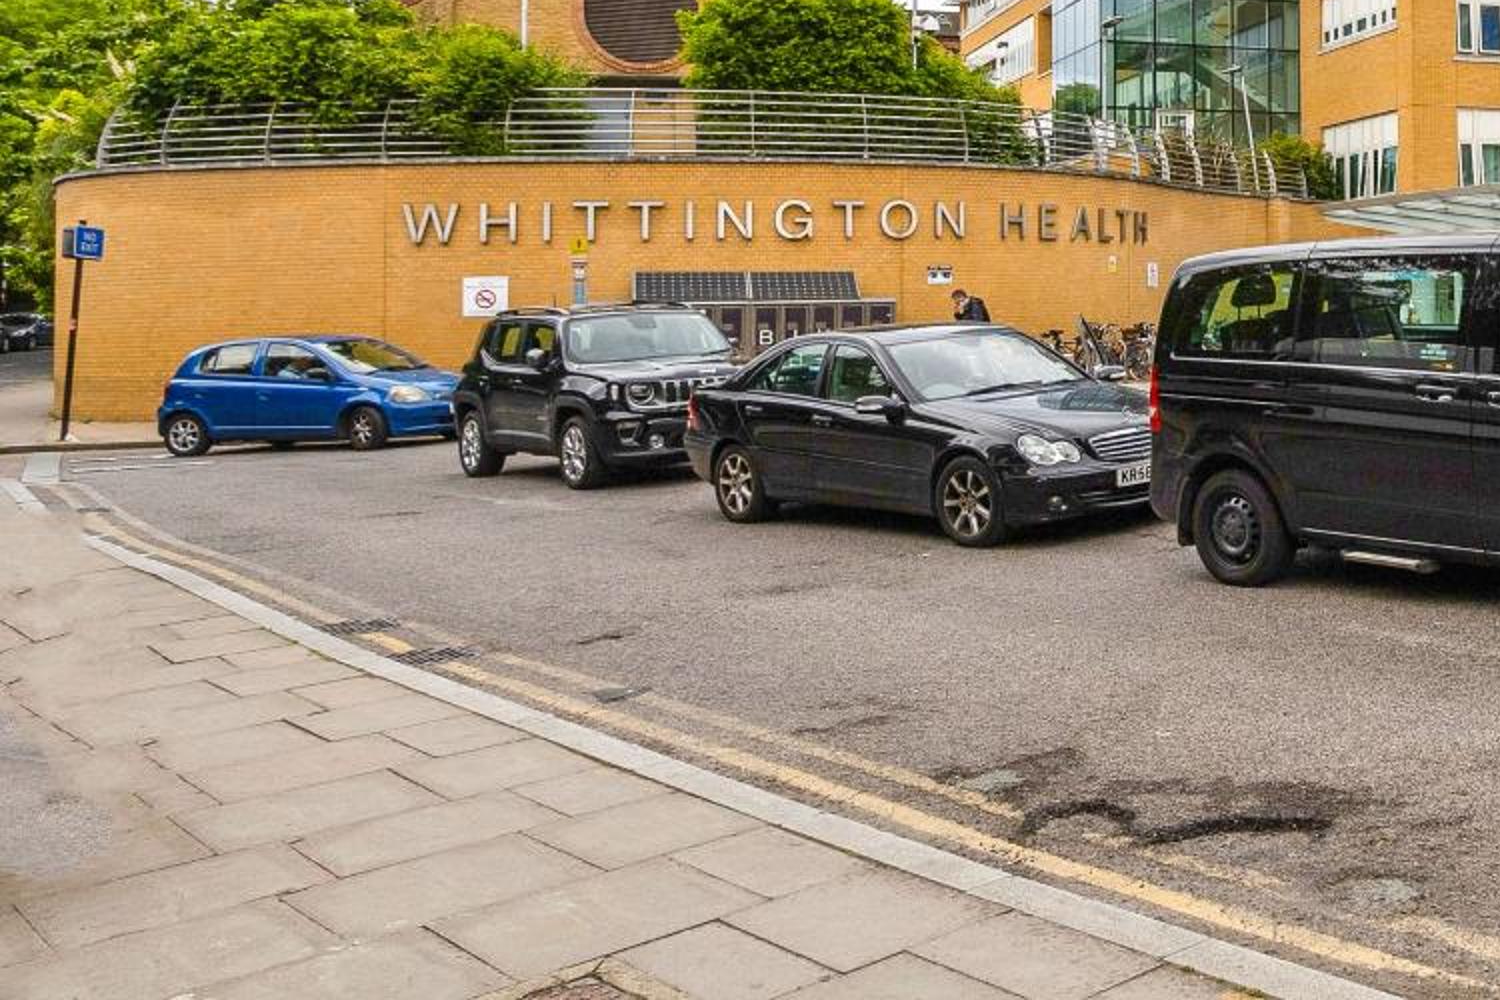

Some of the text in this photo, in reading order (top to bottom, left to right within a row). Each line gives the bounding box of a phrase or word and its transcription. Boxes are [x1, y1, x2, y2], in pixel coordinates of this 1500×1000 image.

[402, 199, 1149, 247] WHITTINGTON HEALTH
[83, 231, 97, 241] NO
[81, 241, 100, 252] EXIT
